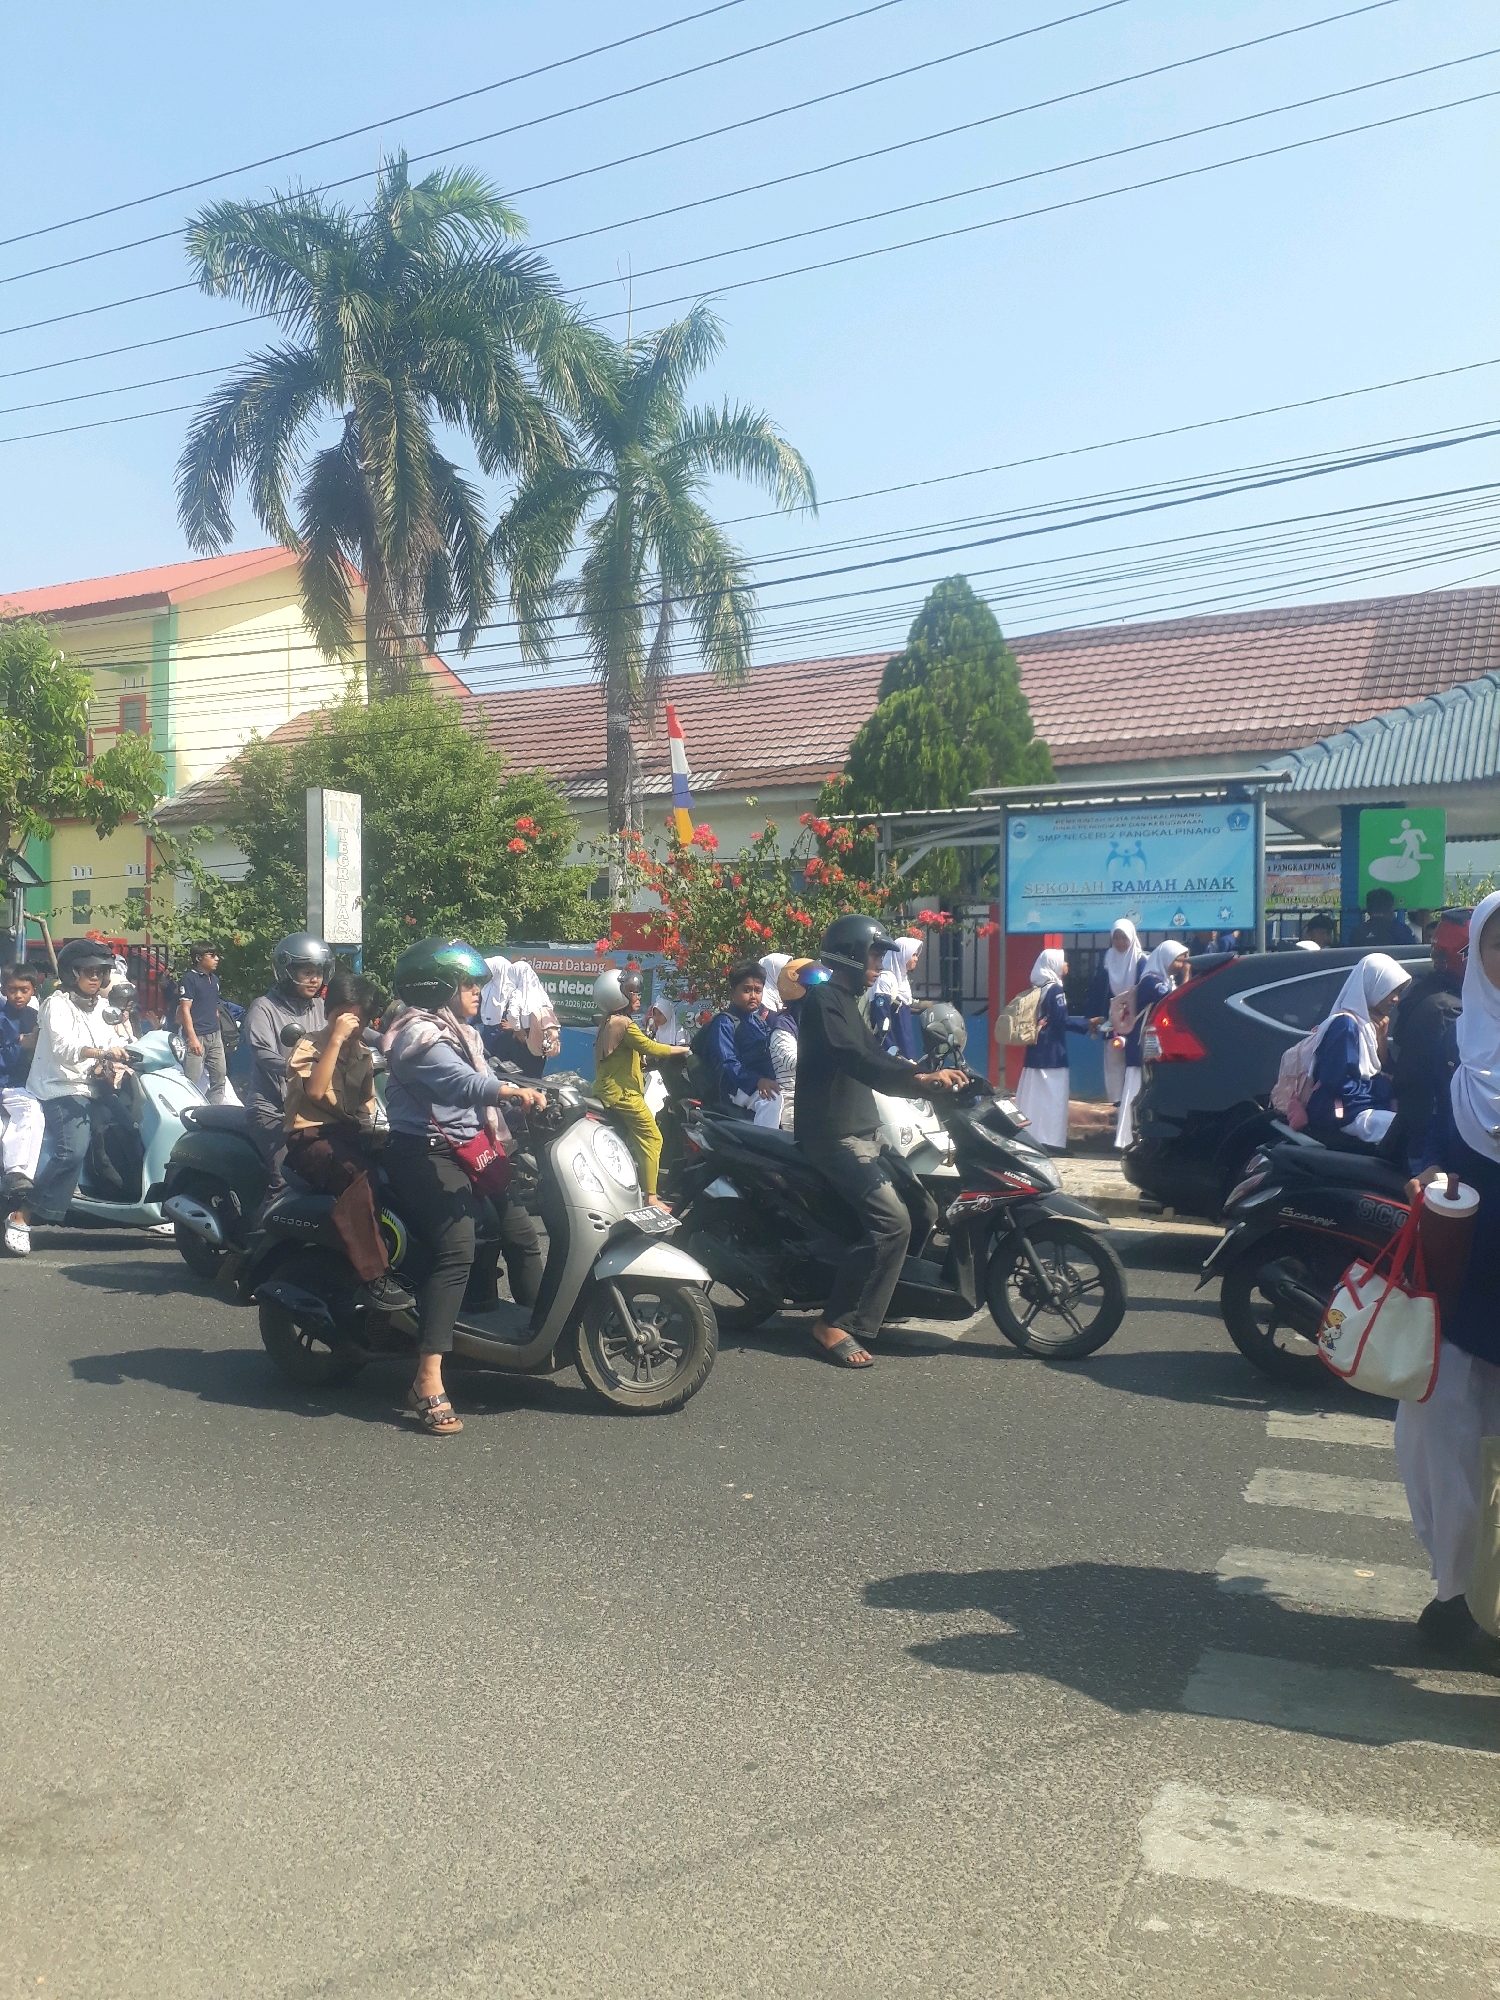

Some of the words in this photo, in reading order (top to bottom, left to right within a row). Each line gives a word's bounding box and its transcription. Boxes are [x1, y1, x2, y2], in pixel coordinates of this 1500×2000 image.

[329, 799, 356, 824] IN
[1131, 812, 1202, 820] PANGKALPINANG
[1148, 819, 1204, 827] KEBUDAYAAN
[1037, 834, 1061, 842] SMP
[1064, 832, 1106, 841] NEGERI
[1109, 831, 1116, 839] 2
[1119, 826, 1221, 838] PANGKALPINANG
[1024, 881, 1105, 895] SEKOLAH
[1112, 879, 1178, 893] RAMAH
[1184, 876, 1235, 891] ANAK
[565, 959, 606, 974] Datang
[559, 980, 594, 996] Heba
[1004, 1171, 1032, 1185] HONDA
